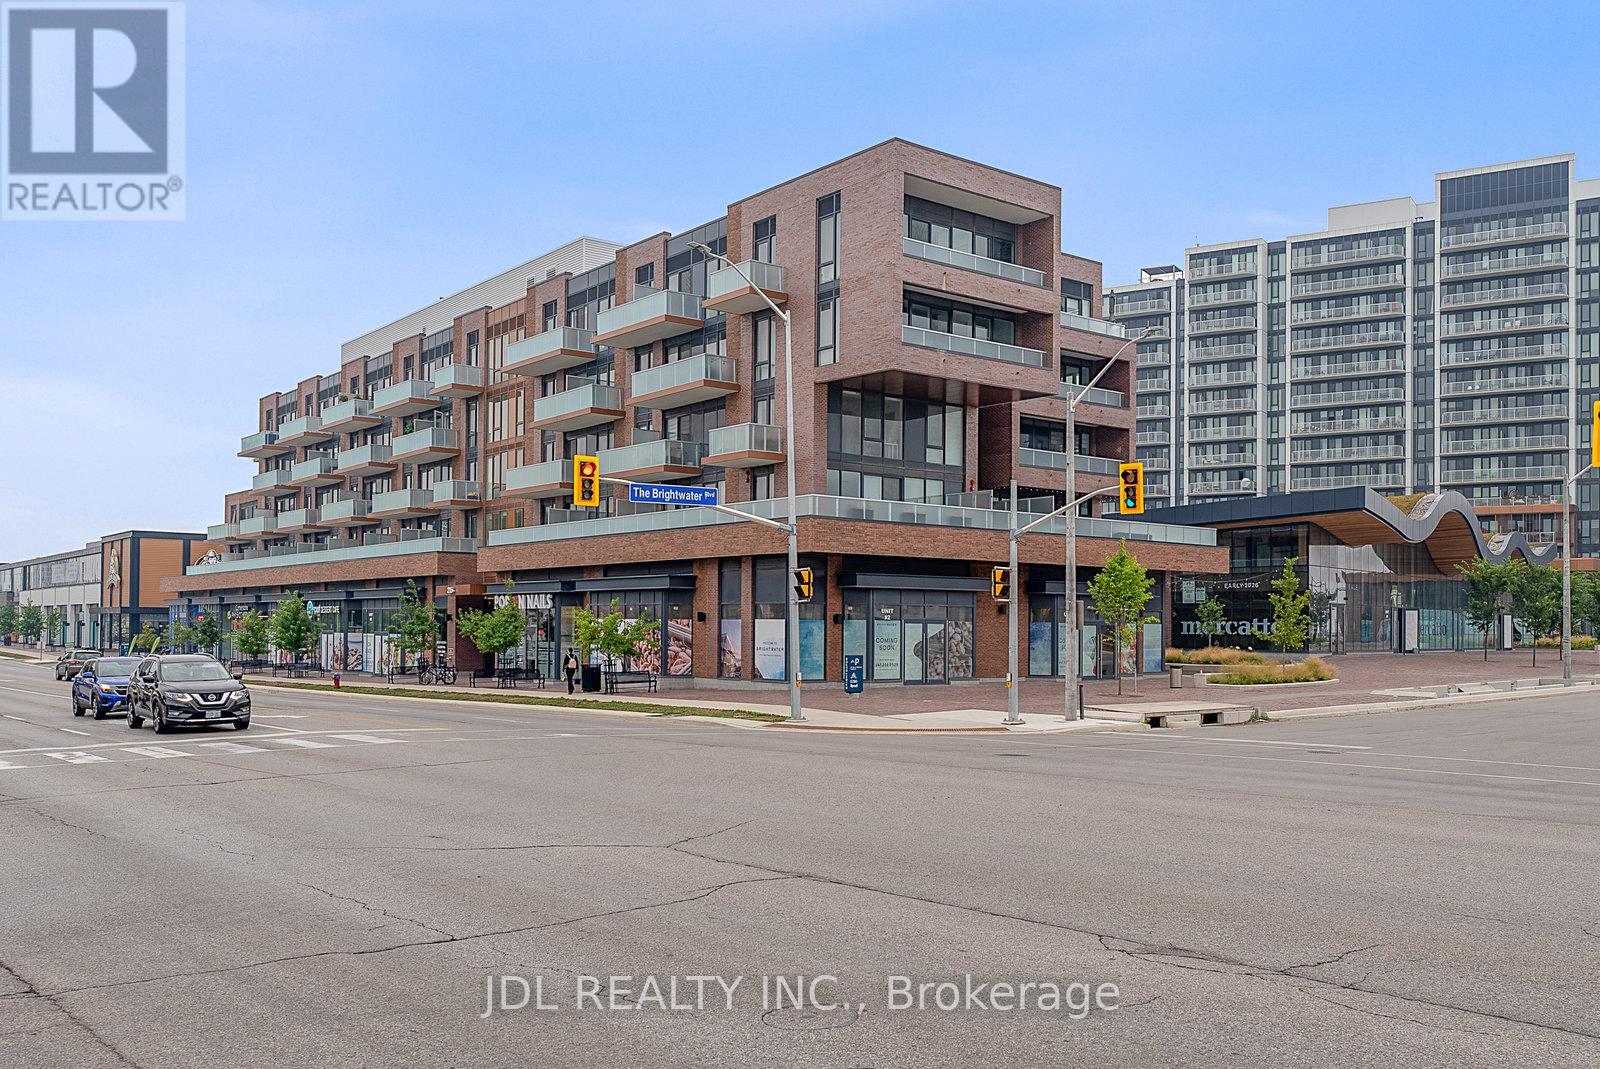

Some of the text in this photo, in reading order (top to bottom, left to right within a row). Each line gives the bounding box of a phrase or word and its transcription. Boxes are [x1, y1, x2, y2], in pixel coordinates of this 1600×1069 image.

[633, 487, 715, 501] The Brightwater Blvd
[527, 594, 553, 609] NAILS
